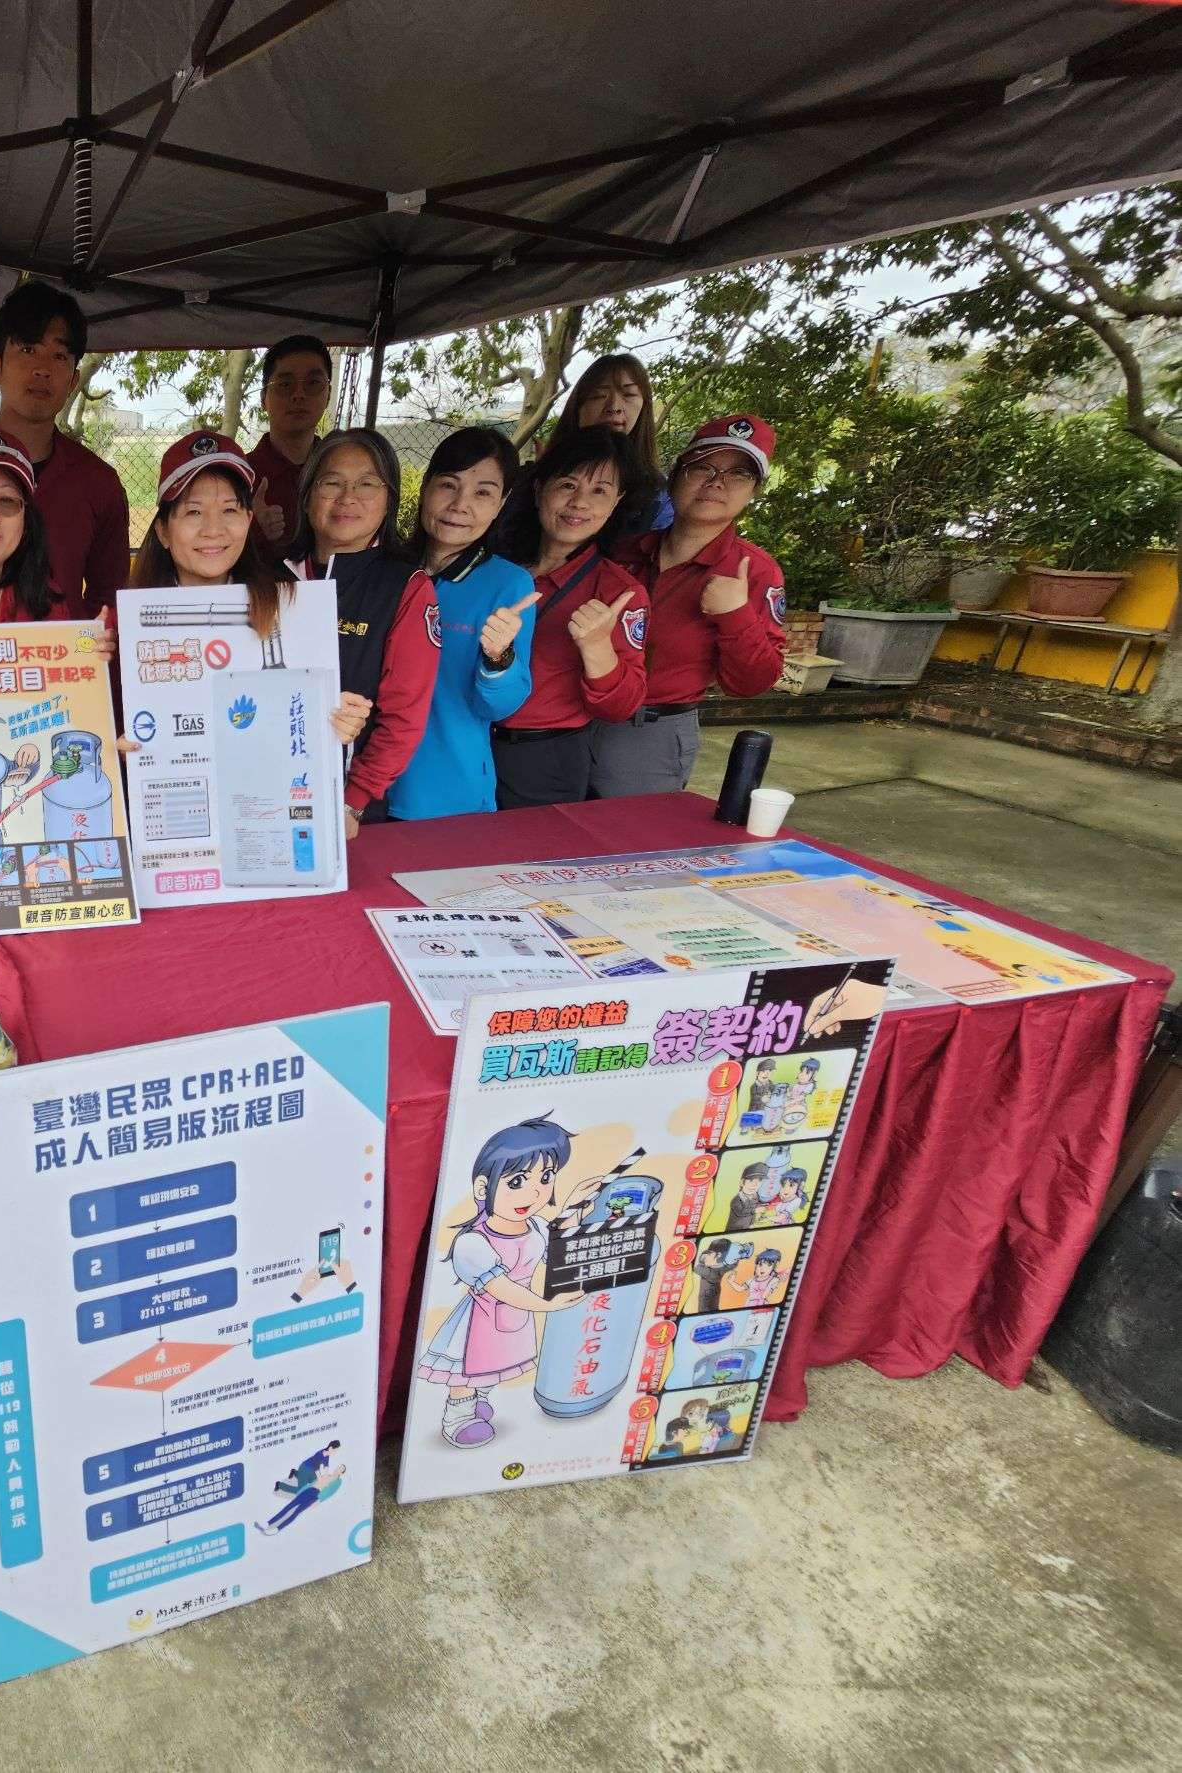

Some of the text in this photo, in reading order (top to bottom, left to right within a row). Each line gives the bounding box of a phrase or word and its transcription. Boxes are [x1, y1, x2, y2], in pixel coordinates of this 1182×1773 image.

[172, 713, 205, 731] TGAS
[289, 692, 307, 757] 莊頭北
[159, 872, 218, 892] 觀音防宣
[24, 902, 126, 924] 觀音防宣關心您
[487, 1000, 629, 1037] 保障您的權益
[649, 1000, 803, 1067] 簽契約
[715, 1066, 730, 1089] 1
[32, 1054, 305, 1135] 臺灣民眾 CPR+AED
[34, 1089, 305, 1174] 成人簡易版流程圖
[691, 1159, 711, 1180] 2
[321, 1236, 339, 1249] 119
[566, 1228, 646, 1252] 家用液化石油氣
[672, 1244, 689, 1266] 3
[90, 1259, 102, 1276] 2
[93, 1311, 106, 1328] 3
[653, 1325, 669, 1344] 4
[636, 1399, 652, 1419] 5
[98, 1464, 110, 1481] 5
[101, 1511, 113, 1528] 6
